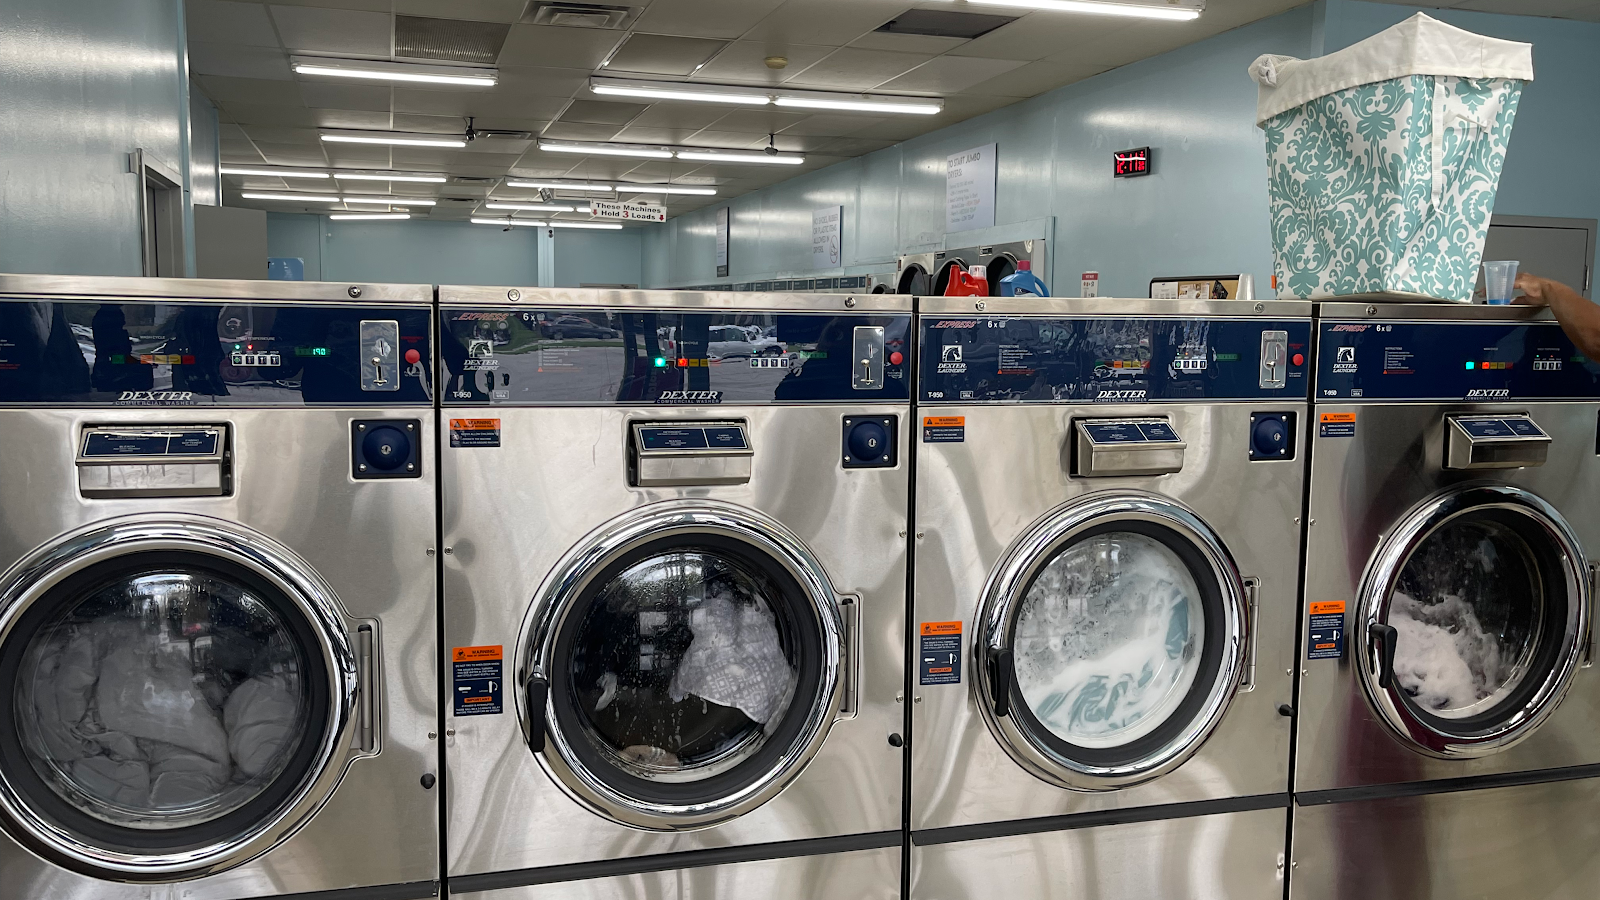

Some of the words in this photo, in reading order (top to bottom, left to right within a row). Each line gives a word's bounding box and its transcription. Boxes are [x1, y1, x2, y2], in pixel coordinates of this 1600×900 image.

[954, 156, 965, 166] START
[966, 152, 980, 164] JUMBO
[624, 204, 661, 214] Machines
[118, 391, 193, 400] DEXTER
[659, 391, 718, 399] DEXTER
[1097, 390, 1146, 398] DEXTER
